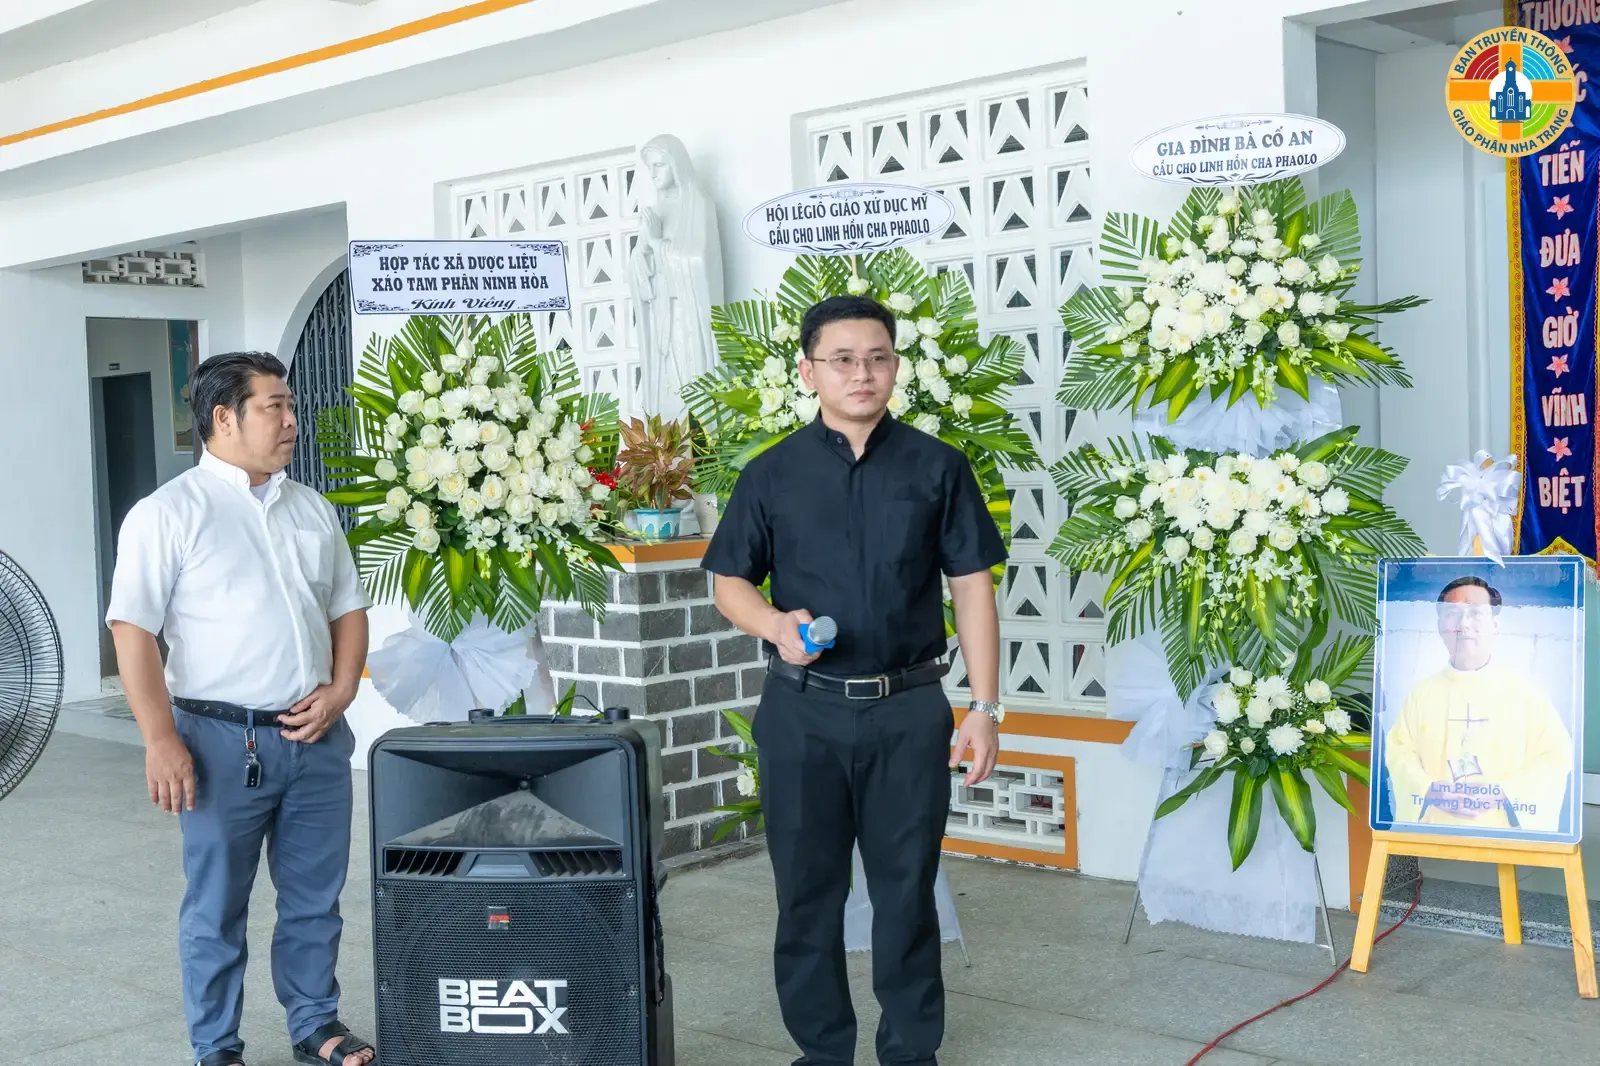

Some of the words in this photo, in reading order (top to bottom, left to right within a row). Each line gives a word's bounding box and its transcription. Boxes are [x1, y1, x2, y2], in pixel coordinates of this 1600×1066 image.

[1157, 140, 1186, 156] GIA
[1190, 134, 1230, 154] ĐÌNH
[1234, 131, 1258, 150] BÀ
[1261, 126, 1284, 148] CỐ
[1288, 130, 1313, 147] AN
[1176, 162, 1197, 174] CHO
[1199, 161, 1224, 173] LINH
[1251, 157, 1273, 169] CHA
[1275, 154, 1318, 167] PHAOLO
[1539, 140, 1585, 186] TIỄN
[792, 201, 826, 220] LÊGIÔ
[829, 199, 860, 217] GIÁO
[863, 197, 881, 215] XỨ
[883, 198, 908, 215] DỤC
[911, 192, 929, 211] MỸ
[793, 227, 814, 243] CHO
[816, 224, 840, 242] LINH
[867, 221, 888, 238] CHA
[890, 218, 930, 237] PHAOLO
[1539, 228, 1580, 268] ĐƯA
[379, 255, 409, 274] HỢP
[413, 253, 440, 270] TÁC
[443, 253, 464, 270] XÃ
[468, 256, 504, 272] DƯỢC
[508, 253, 538, 272] LIỆU
[371, 274, 403, 292] XÁO
[407, 277, 437, 291] TAM
[441, 273, 479, 291] PHÂN
[482, 276, 517, 290] NINH
[520, 273, 549, 289] HÒA
[411, 297, 456, 310] Kính
[462, 296, 516, 310] Viếng
[1542, 306, 1579, 349] GIỜ
[1541, 387, 1587, 426] VĨNH
[1538, 467, 1585, 514] BIỆT
[1431, 781, 1450, 793] Lm
[1454, 783, 1500, 796] Phaolô
[438, 979, 568, 1012] BEAT
[439, 1005, 569, 1034] BOX
